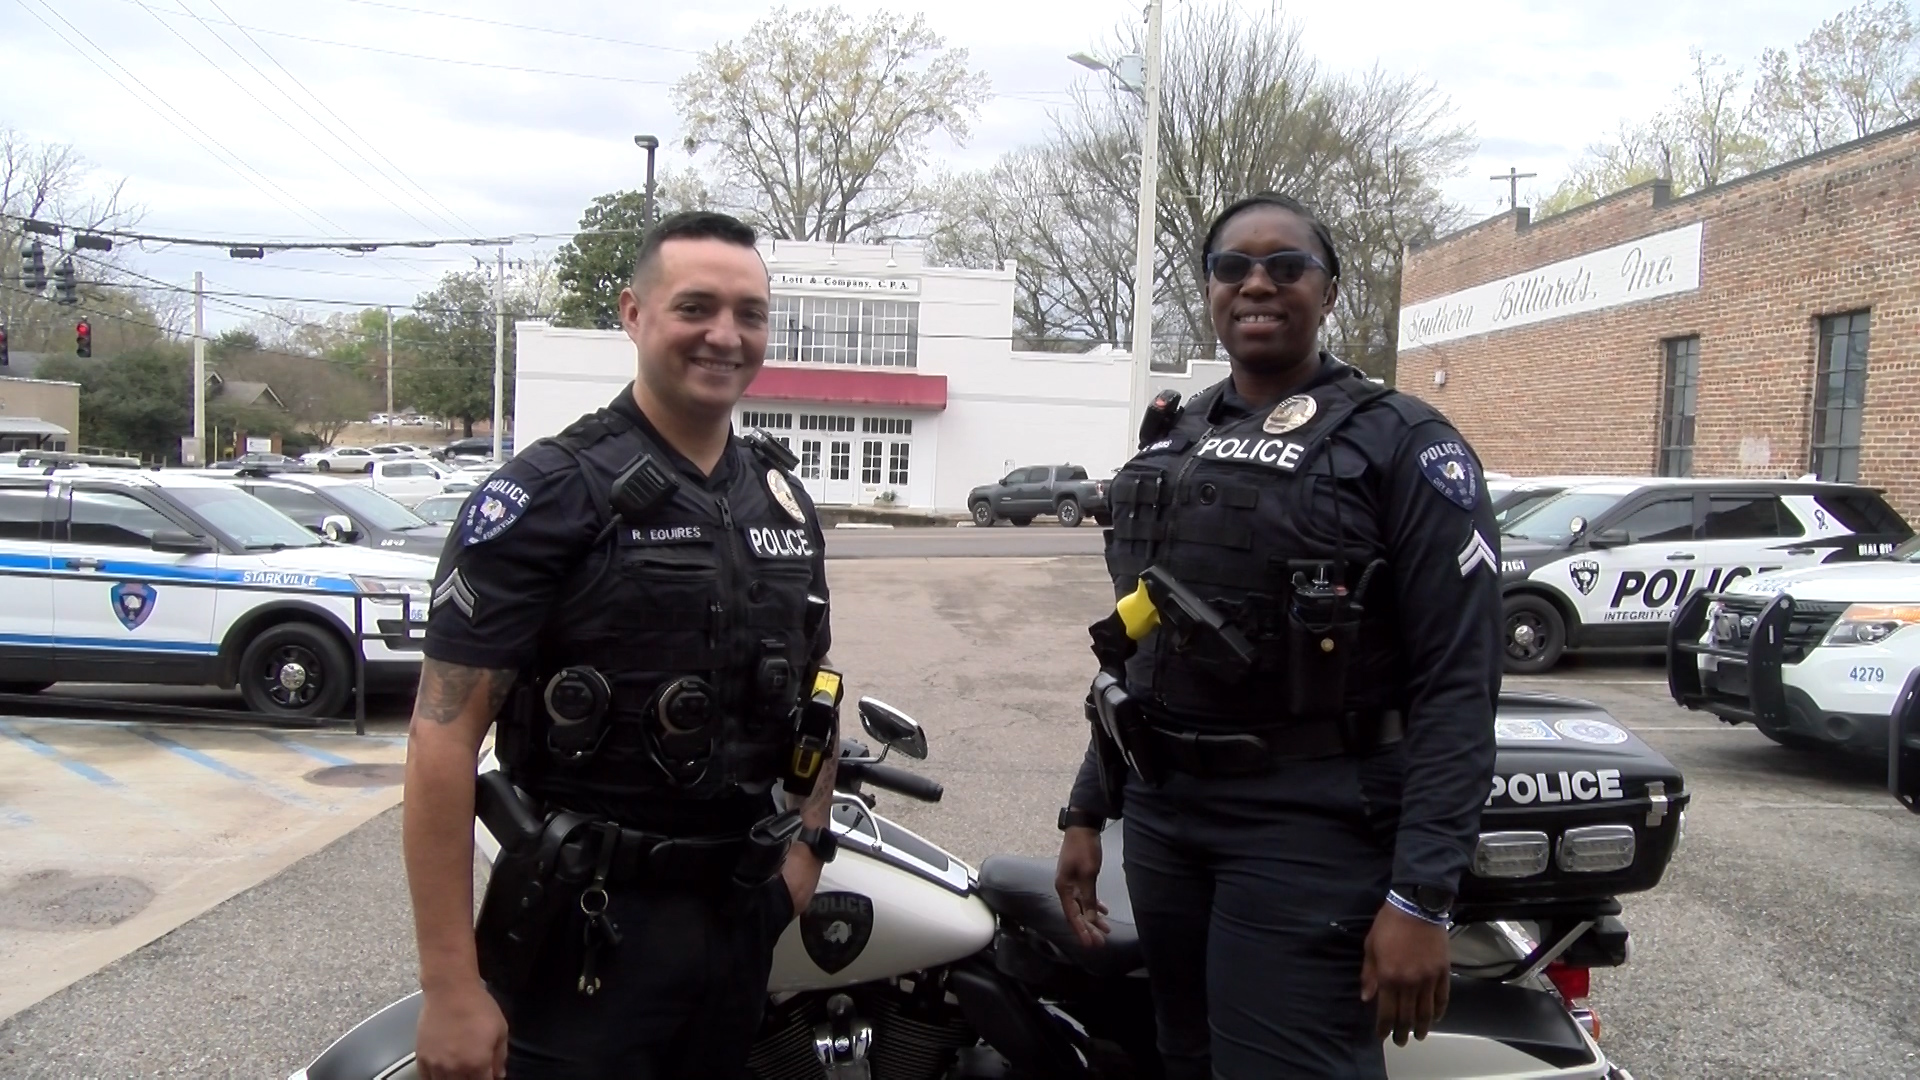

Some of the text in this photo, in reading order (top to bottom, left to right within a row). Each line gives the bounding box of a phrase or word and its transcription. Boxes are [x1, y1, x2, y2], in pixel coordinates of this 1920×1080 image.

[782, 275, 803, 284] Lott
[1407, 302, 1473, 341] Southern
[1621, 247, 1673, 291] Inc.
[1197, 437, 1305, 468] POLICE
[1420, 442, 1465, 468] POLICE
[482, 478, 530, 508] POLICE
[749, 527, 814, 556] POLICE
[243, 571, 318, 586] STARKVILLE
[1604, 610, 1664, 621] INTEGRITY
[1849, 666, 1884, 682] 4279
[1484, 768, 1623, 806] POLICE
